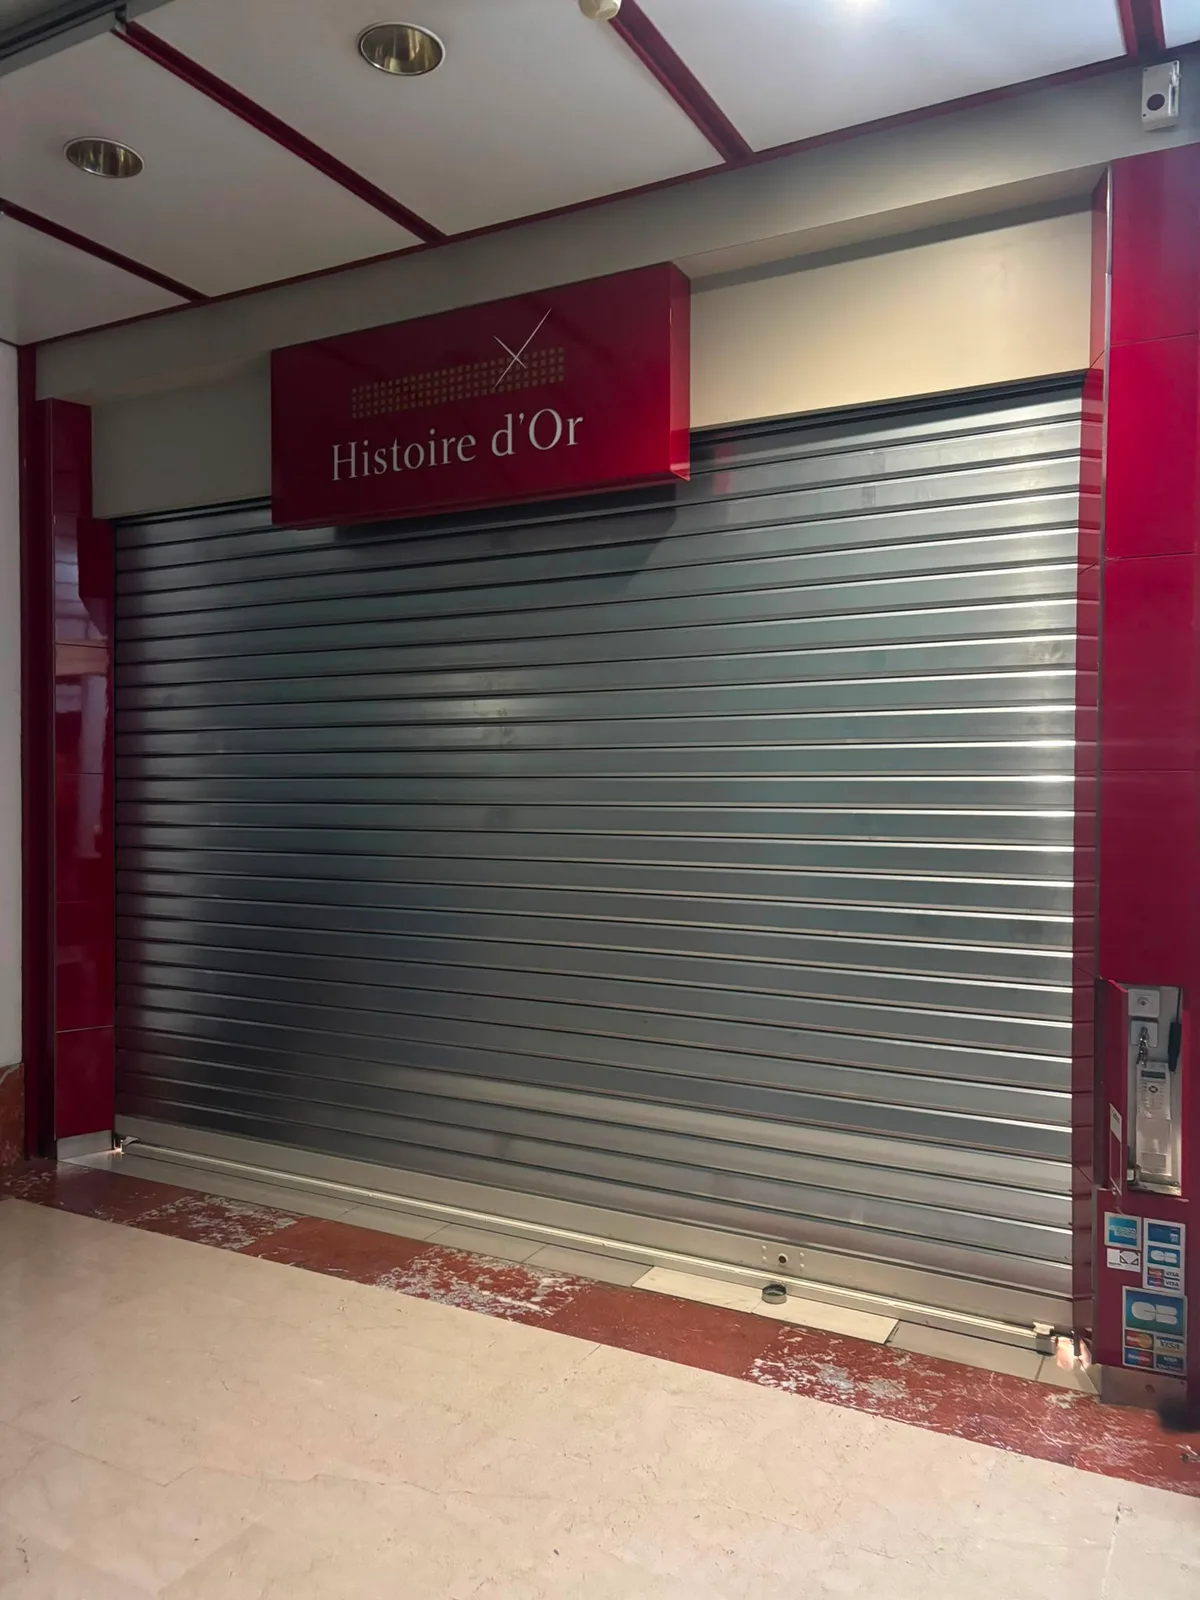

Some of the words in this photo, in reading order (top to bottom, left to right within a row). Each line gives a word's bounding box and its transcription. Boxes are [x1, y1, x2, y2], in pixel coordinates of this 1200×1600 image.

[332, 428, 476, 481] Histoire
[491, 408, 584, 457] d'Or
[1131, 1301, 1178, 1325] CB
